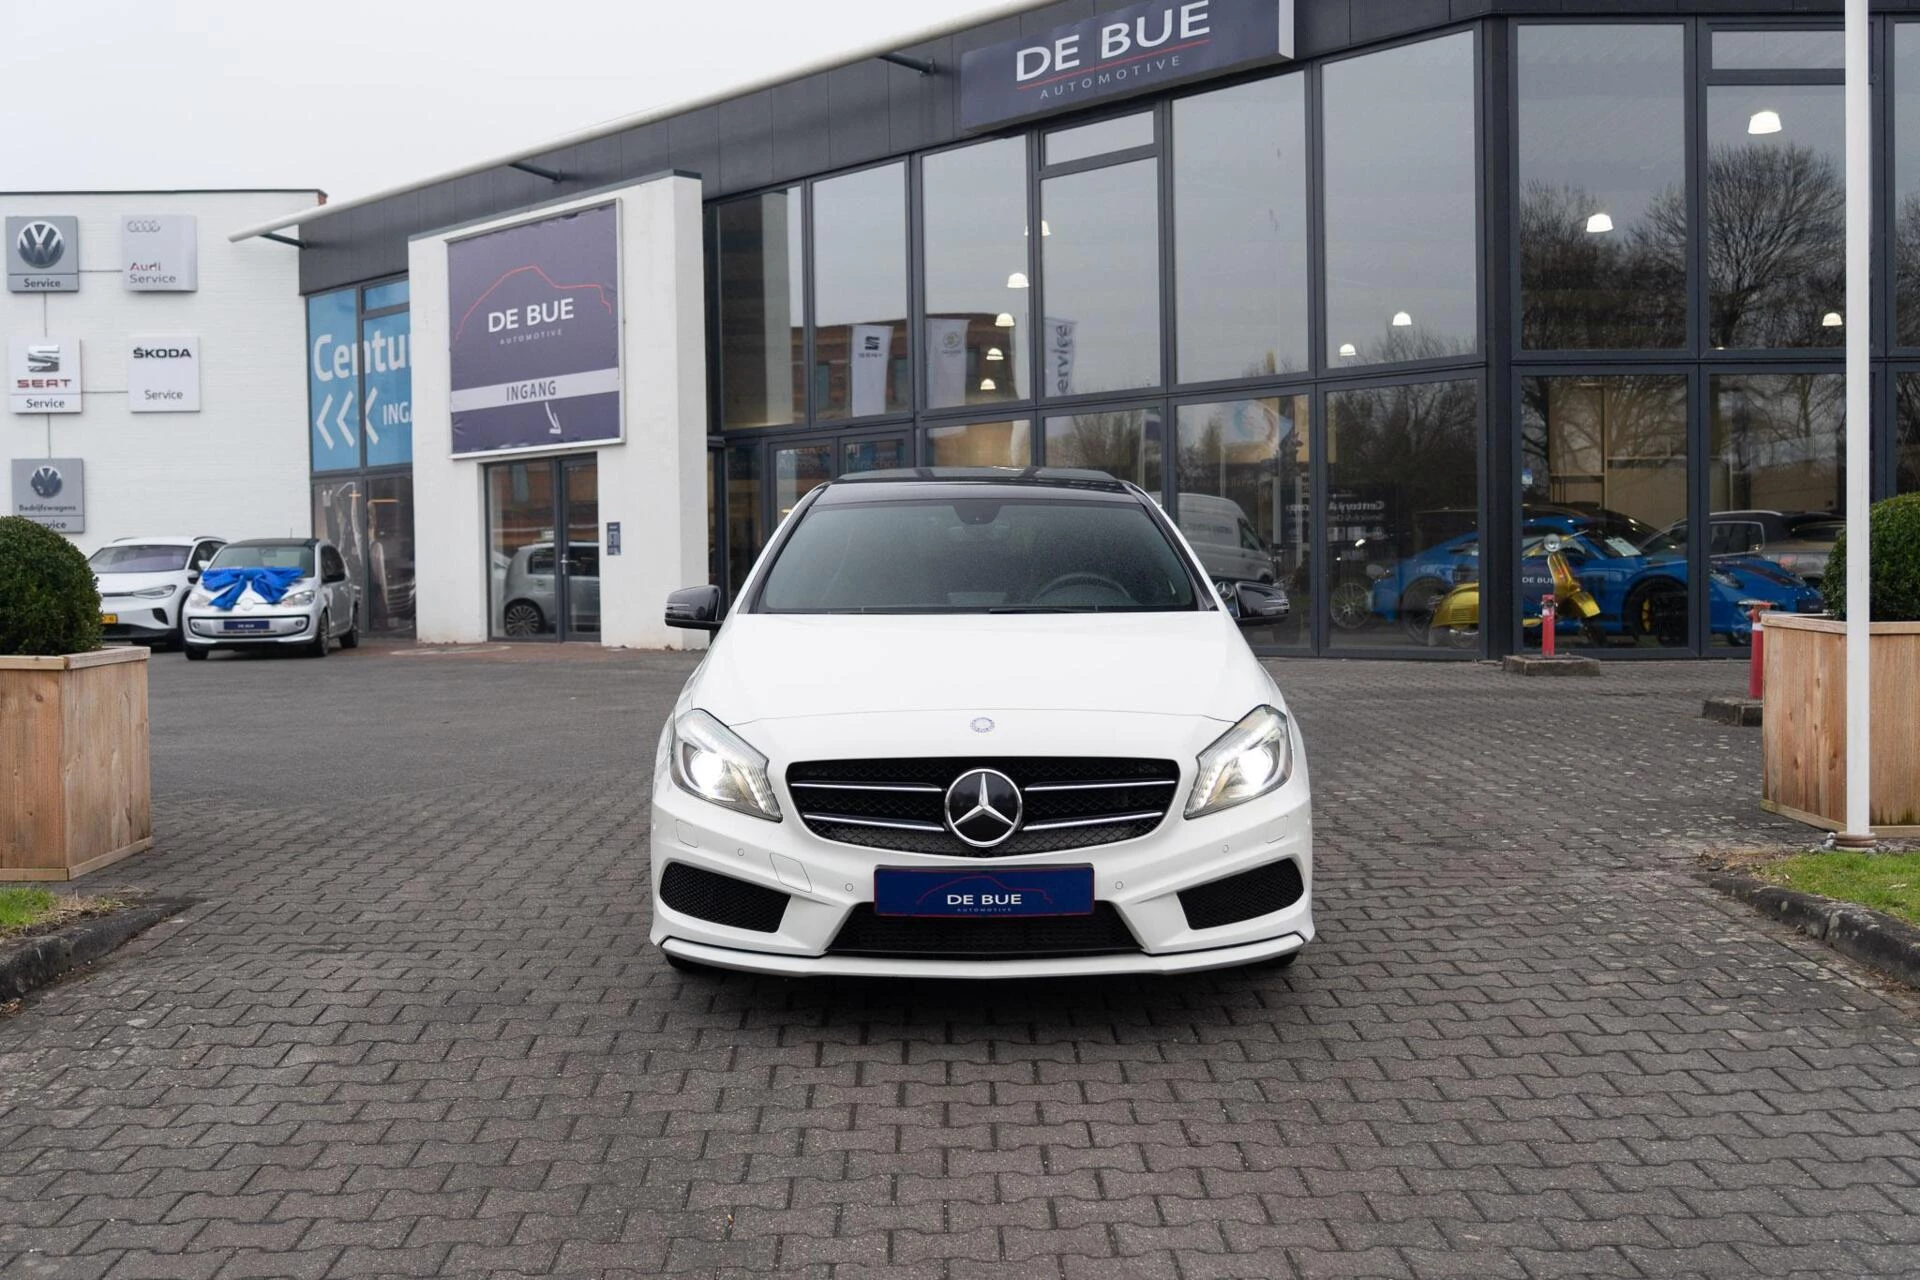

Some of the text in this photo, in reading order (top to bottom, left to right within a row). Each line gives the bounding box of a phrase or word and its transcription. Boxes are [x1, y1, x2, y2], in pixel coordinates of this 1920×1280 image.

[1016, 0, 1211, 82] DE BUE
[1040, 55, 1181, 100] AUTOMOTIVE
[130, 262, 162, 272] Audi
[24, 278, 61, 288] Service
[129, 274, 177, 284] Service
[488, 298, 575, 333] DE BUE
[500, 329, 563, 345] AUTOMOTIVE
[133, 347, 192, 359] ŠKODA
[17, 379, 72, 388] SEAT
[144, 390, 184, 400] Service
[506, 380, 557, 402] INGANG
[26, 399, 65, 409] Service
[383, 402, 413, 426] ING
[947, 893, 1022, 905] DE BUE
